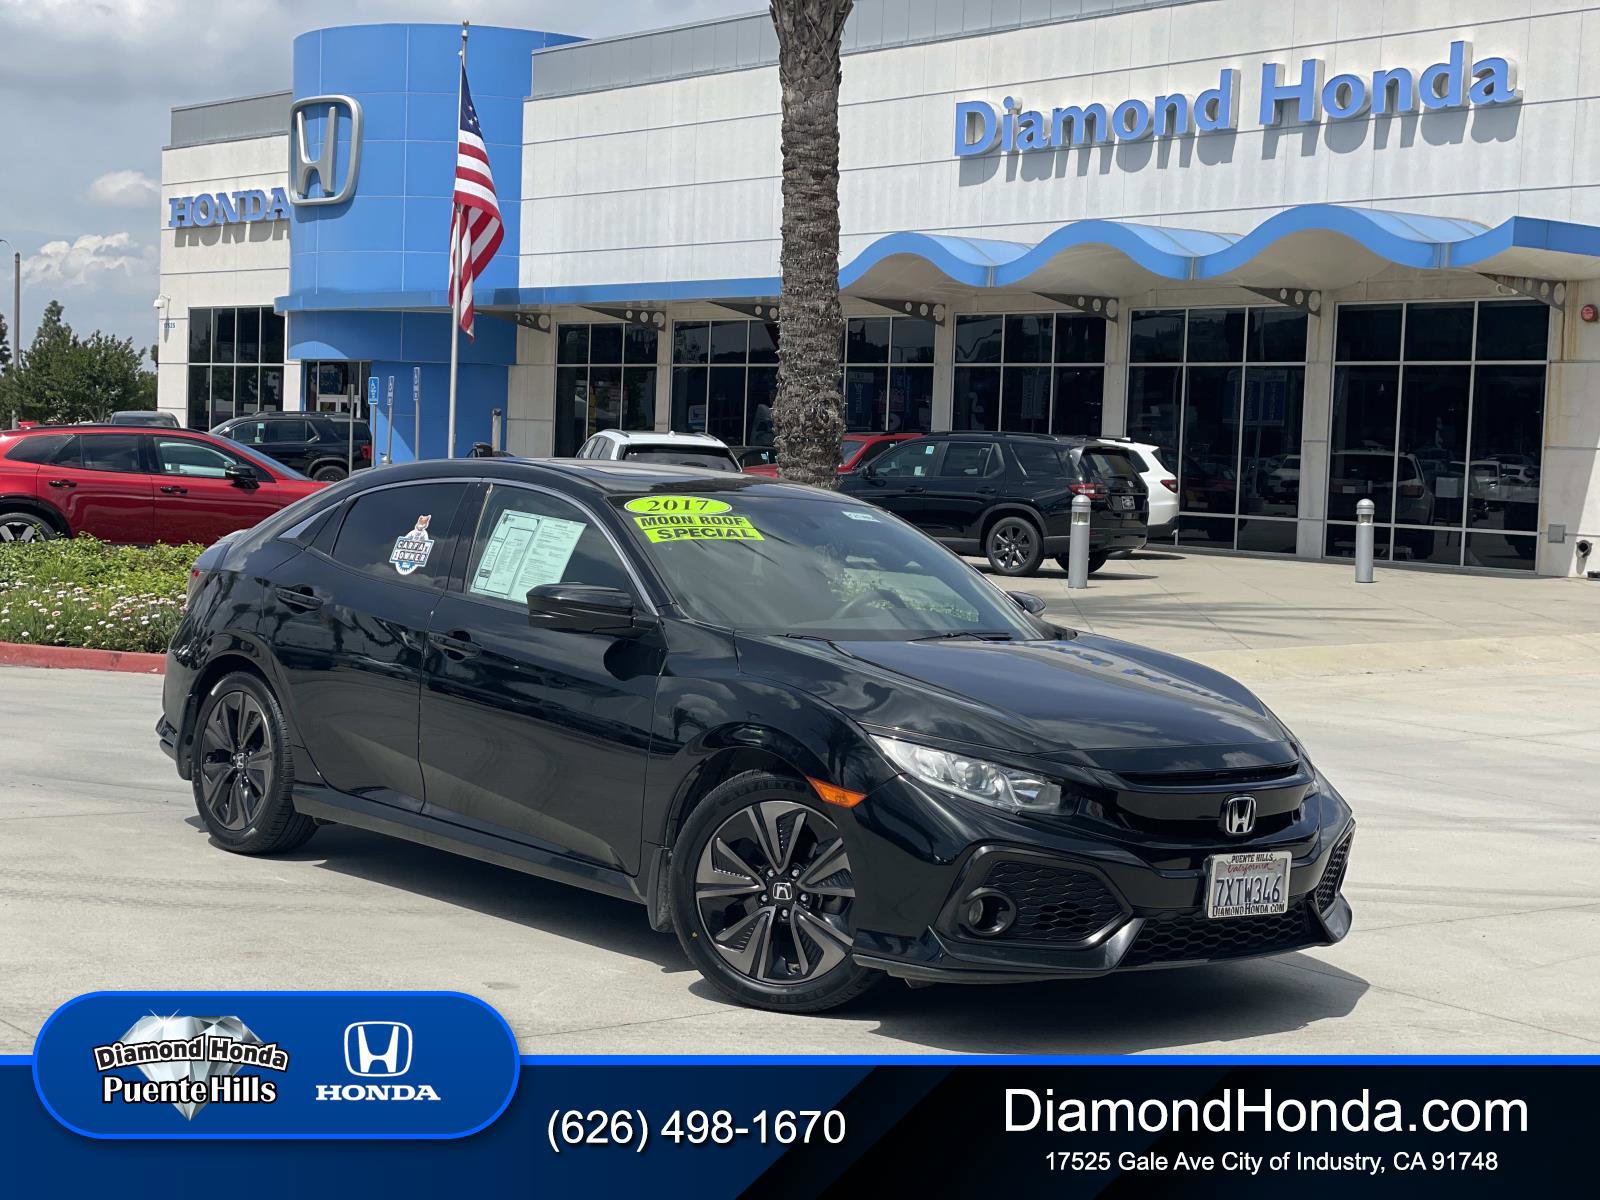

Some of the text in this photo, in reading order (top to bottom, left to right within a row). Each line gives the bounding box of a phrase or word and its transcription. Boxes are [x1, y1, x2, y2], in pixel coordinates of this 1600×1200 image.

[956, 40, 1522, 156] Diamond Honda
[168, 187, 290, 227] HONDA
[647, 499, 709, 512] 2017
[640, 515, 743, 527] MOON ROOF
[656, 528, 755, 539] SPECIAL
[1231, 853, 1274, 864] PUENTE HILLS
[1227, 863, 1274, 875] California
[1216, 875, 1282, 907] 7XTW346
